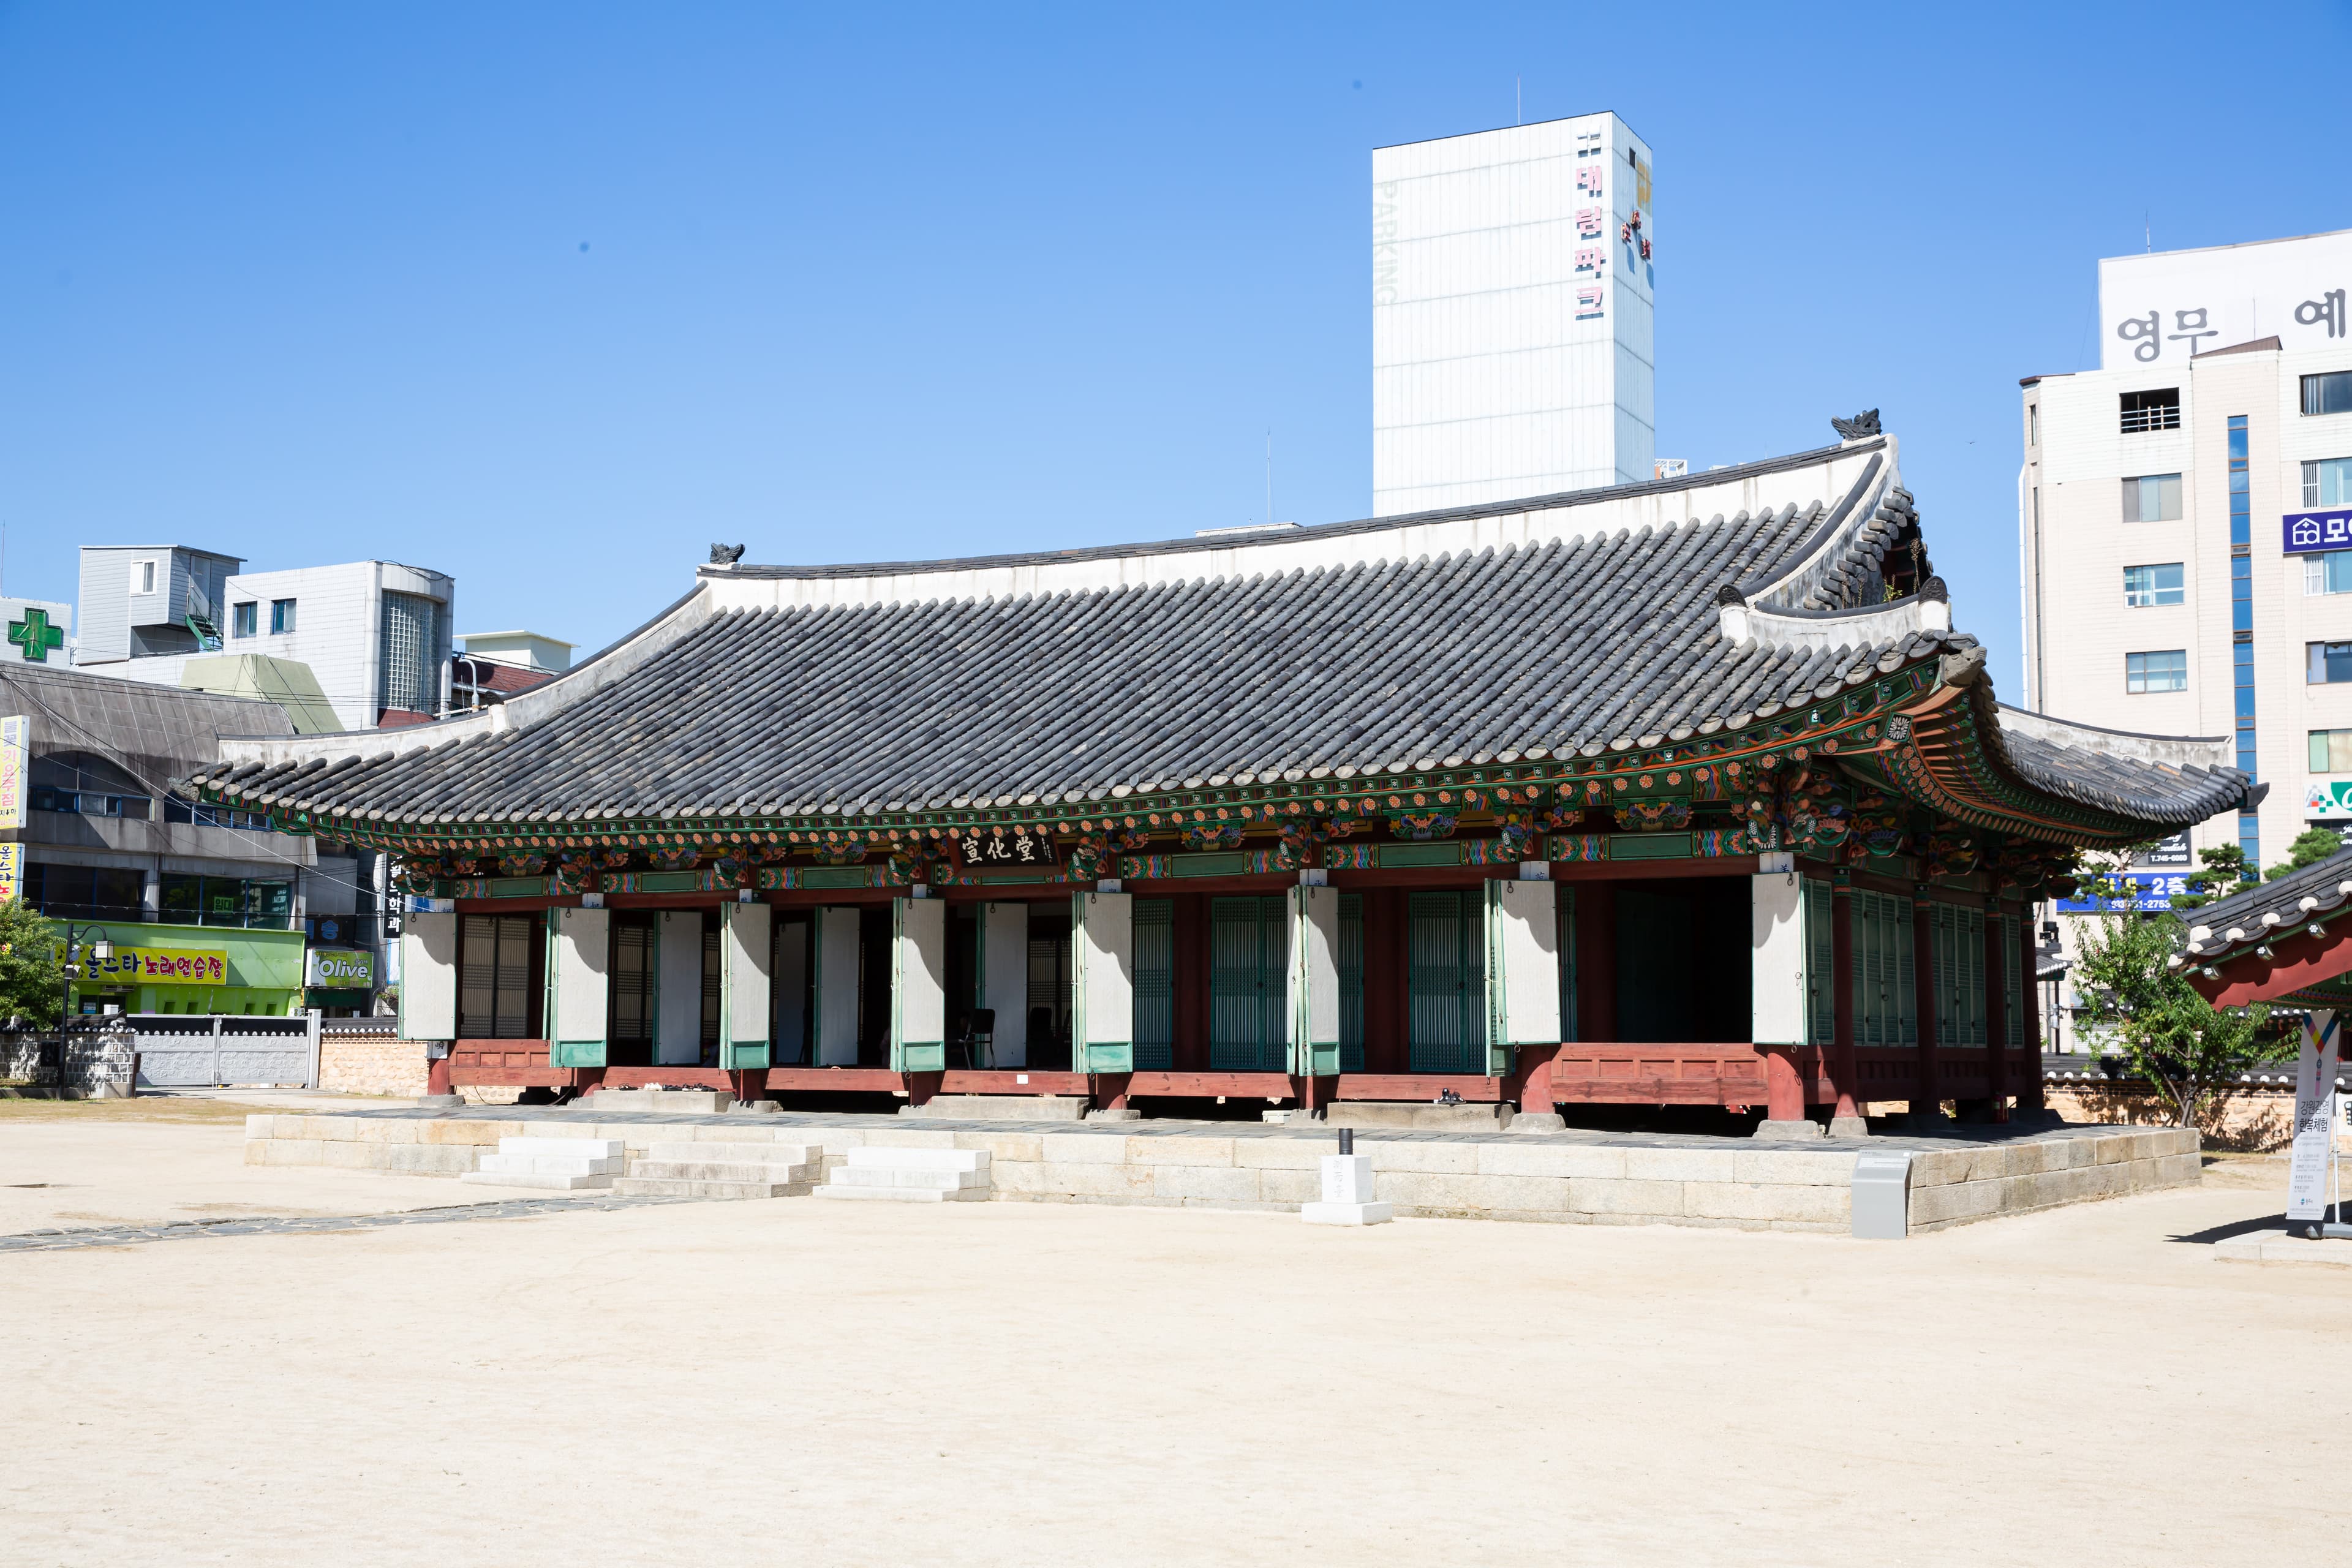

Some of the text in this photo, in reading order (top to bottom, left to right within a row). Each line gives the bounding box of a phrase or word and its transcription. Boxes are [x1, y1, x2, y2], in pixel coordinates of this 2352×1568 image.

[1373, 181, 1398, 306] PARKING
[1574, 165, 1605, 314] 대림파크
[2117, 288, 2346, 362] 영무 예
[2324, 518, 2352, 543] 모
[962, 836, 1035, 864] 宣化堂
[2152, 876, 2186, 895] 2층
[215, 899, 233, 910] 임대
[145, 955, 223, 979] 노래연습장
[318, 959, 368, 978] Olive
[2301, 1100, 2329, 1115] 강원감영
[2299, 1118, 2328, 1132] 한복체험
